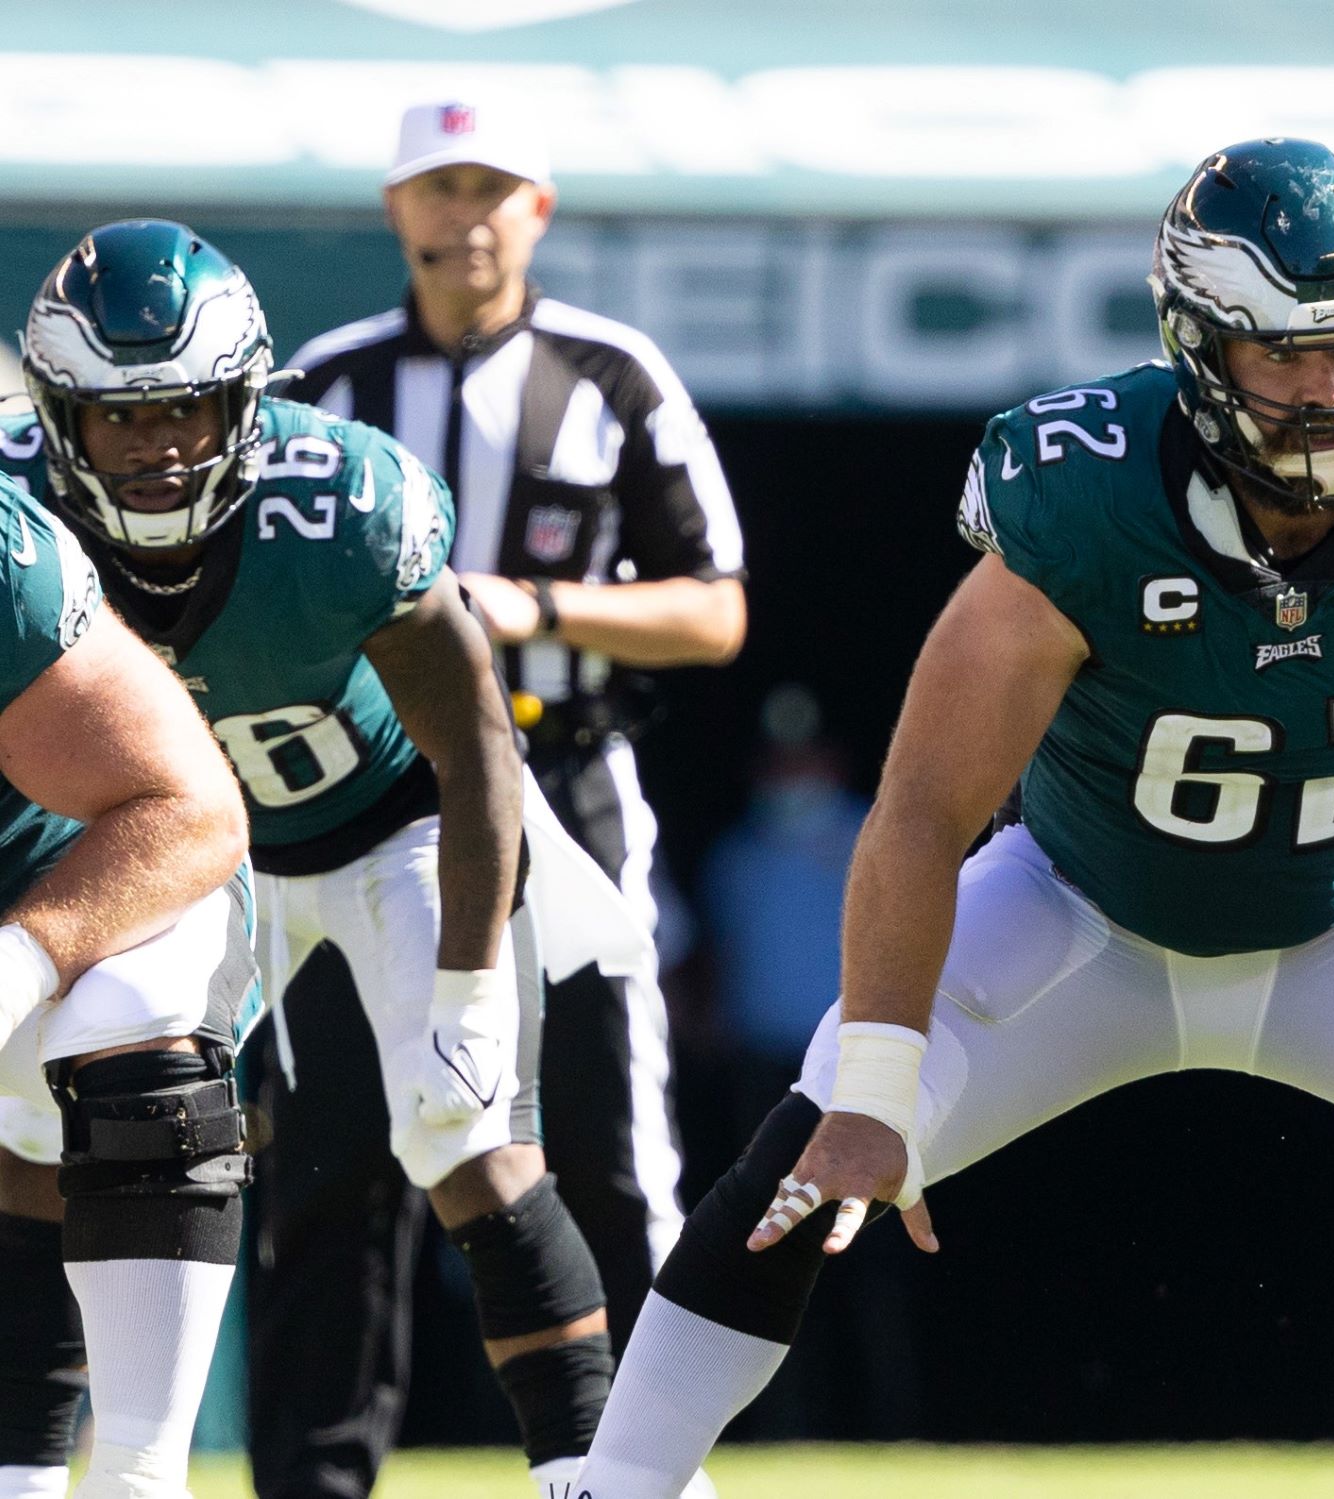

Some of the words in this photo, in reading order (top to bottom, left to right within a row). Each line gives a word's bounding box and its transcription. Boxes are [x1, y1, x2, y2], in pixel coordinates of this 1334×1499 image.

[1025, 386, 1128, 464] 62
[256, 434, 342, 541] 26
[1142, 576, 1199, 622] C
[1281, 606, 1304, 626] NFL
[1254, 633, 1323, 671] EAGLES
